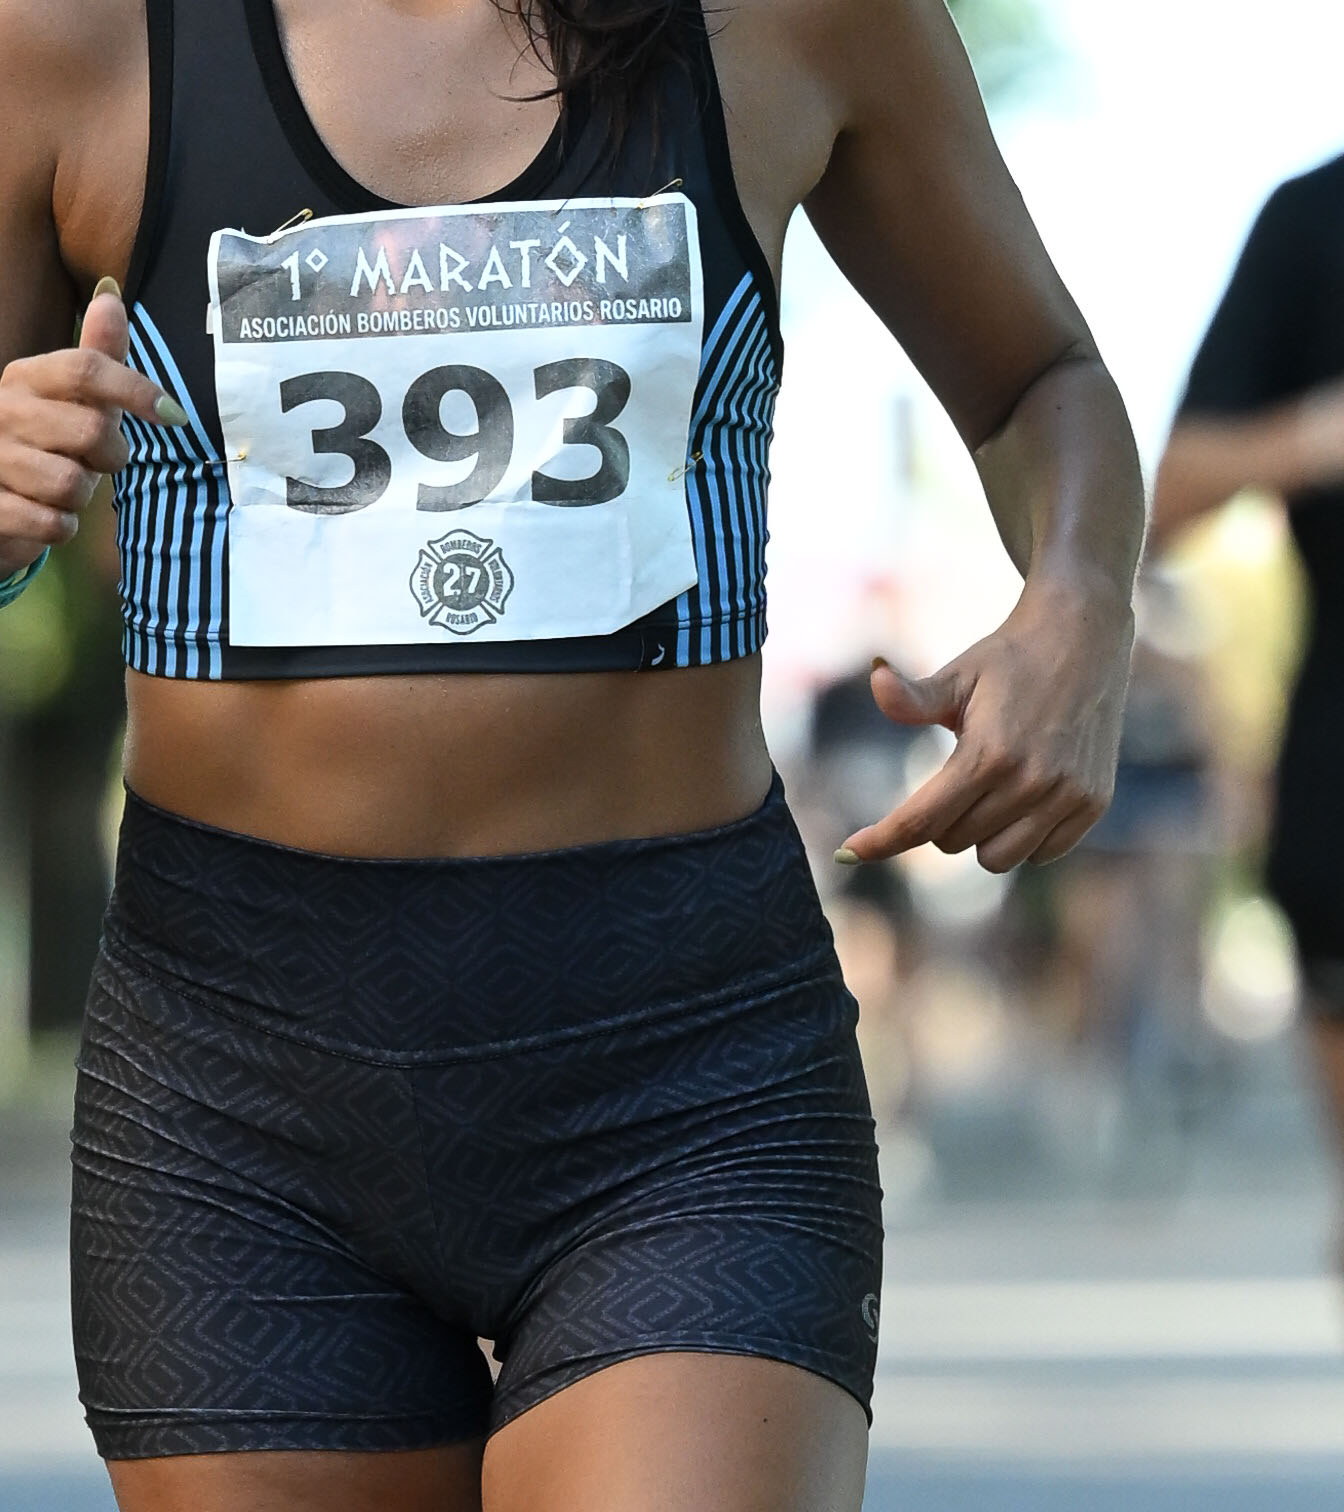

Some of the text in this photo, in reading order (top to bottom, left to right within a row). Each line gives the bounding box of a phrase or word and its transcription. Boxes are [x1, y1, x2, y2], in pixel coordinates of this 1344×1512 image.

[350, 221, 628, 298] MARATÓN
[239, 297, 683, 339] ASOCIACIÓN BOMBEROS VOLUNTARIOS ROSARIO
[280, 358, 633, 516] 393
[443, 562, 482, 597] 27
